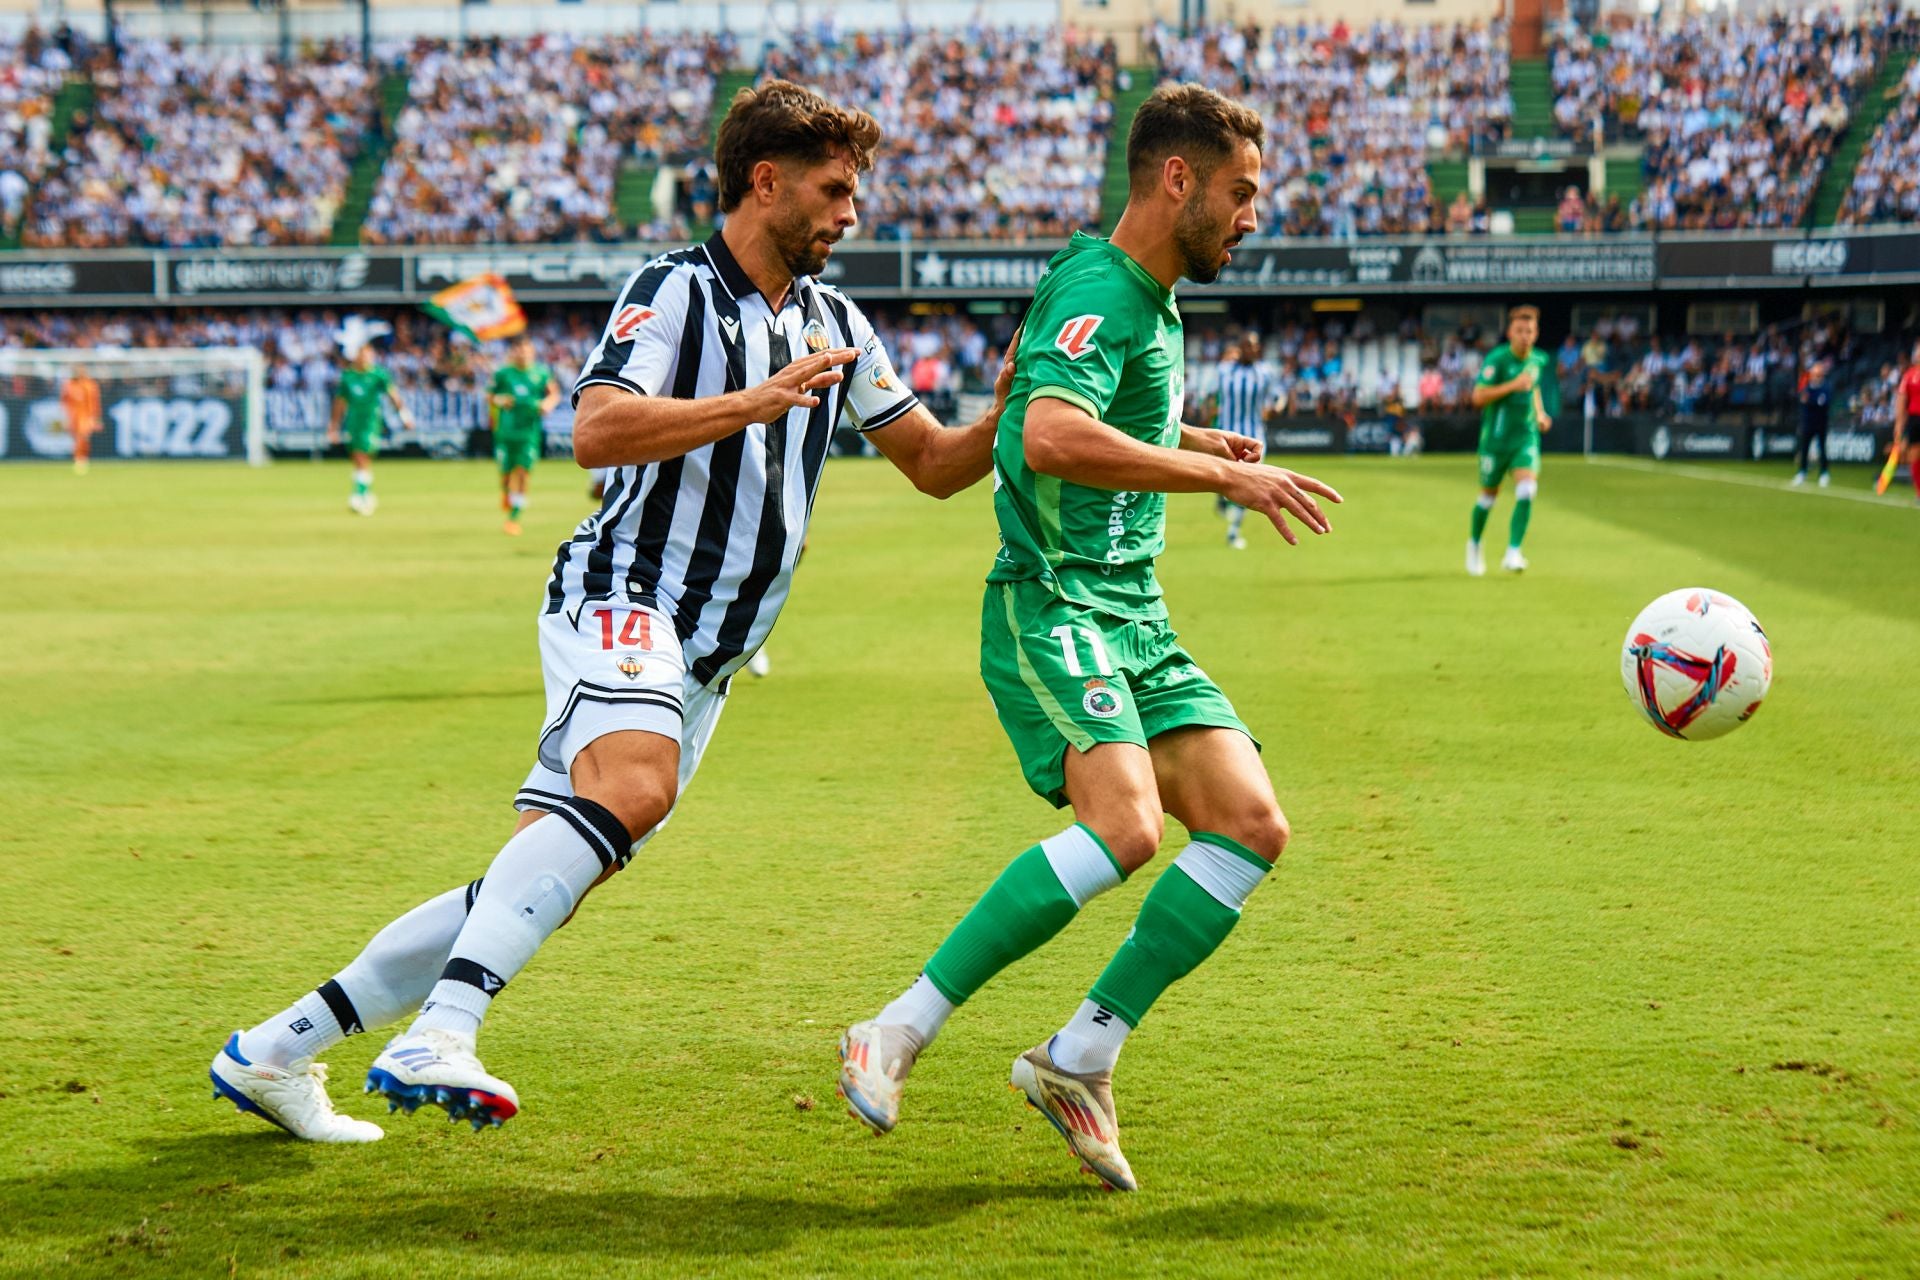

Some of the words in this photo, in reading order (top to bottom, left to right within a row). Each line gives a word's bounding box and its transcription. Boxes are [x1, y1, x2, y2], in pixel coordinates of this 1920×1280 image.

[109, 398, 231, 456] 1922
[593, 609, 653, 650] 14
[1050, 625, 1113, 676] 11
